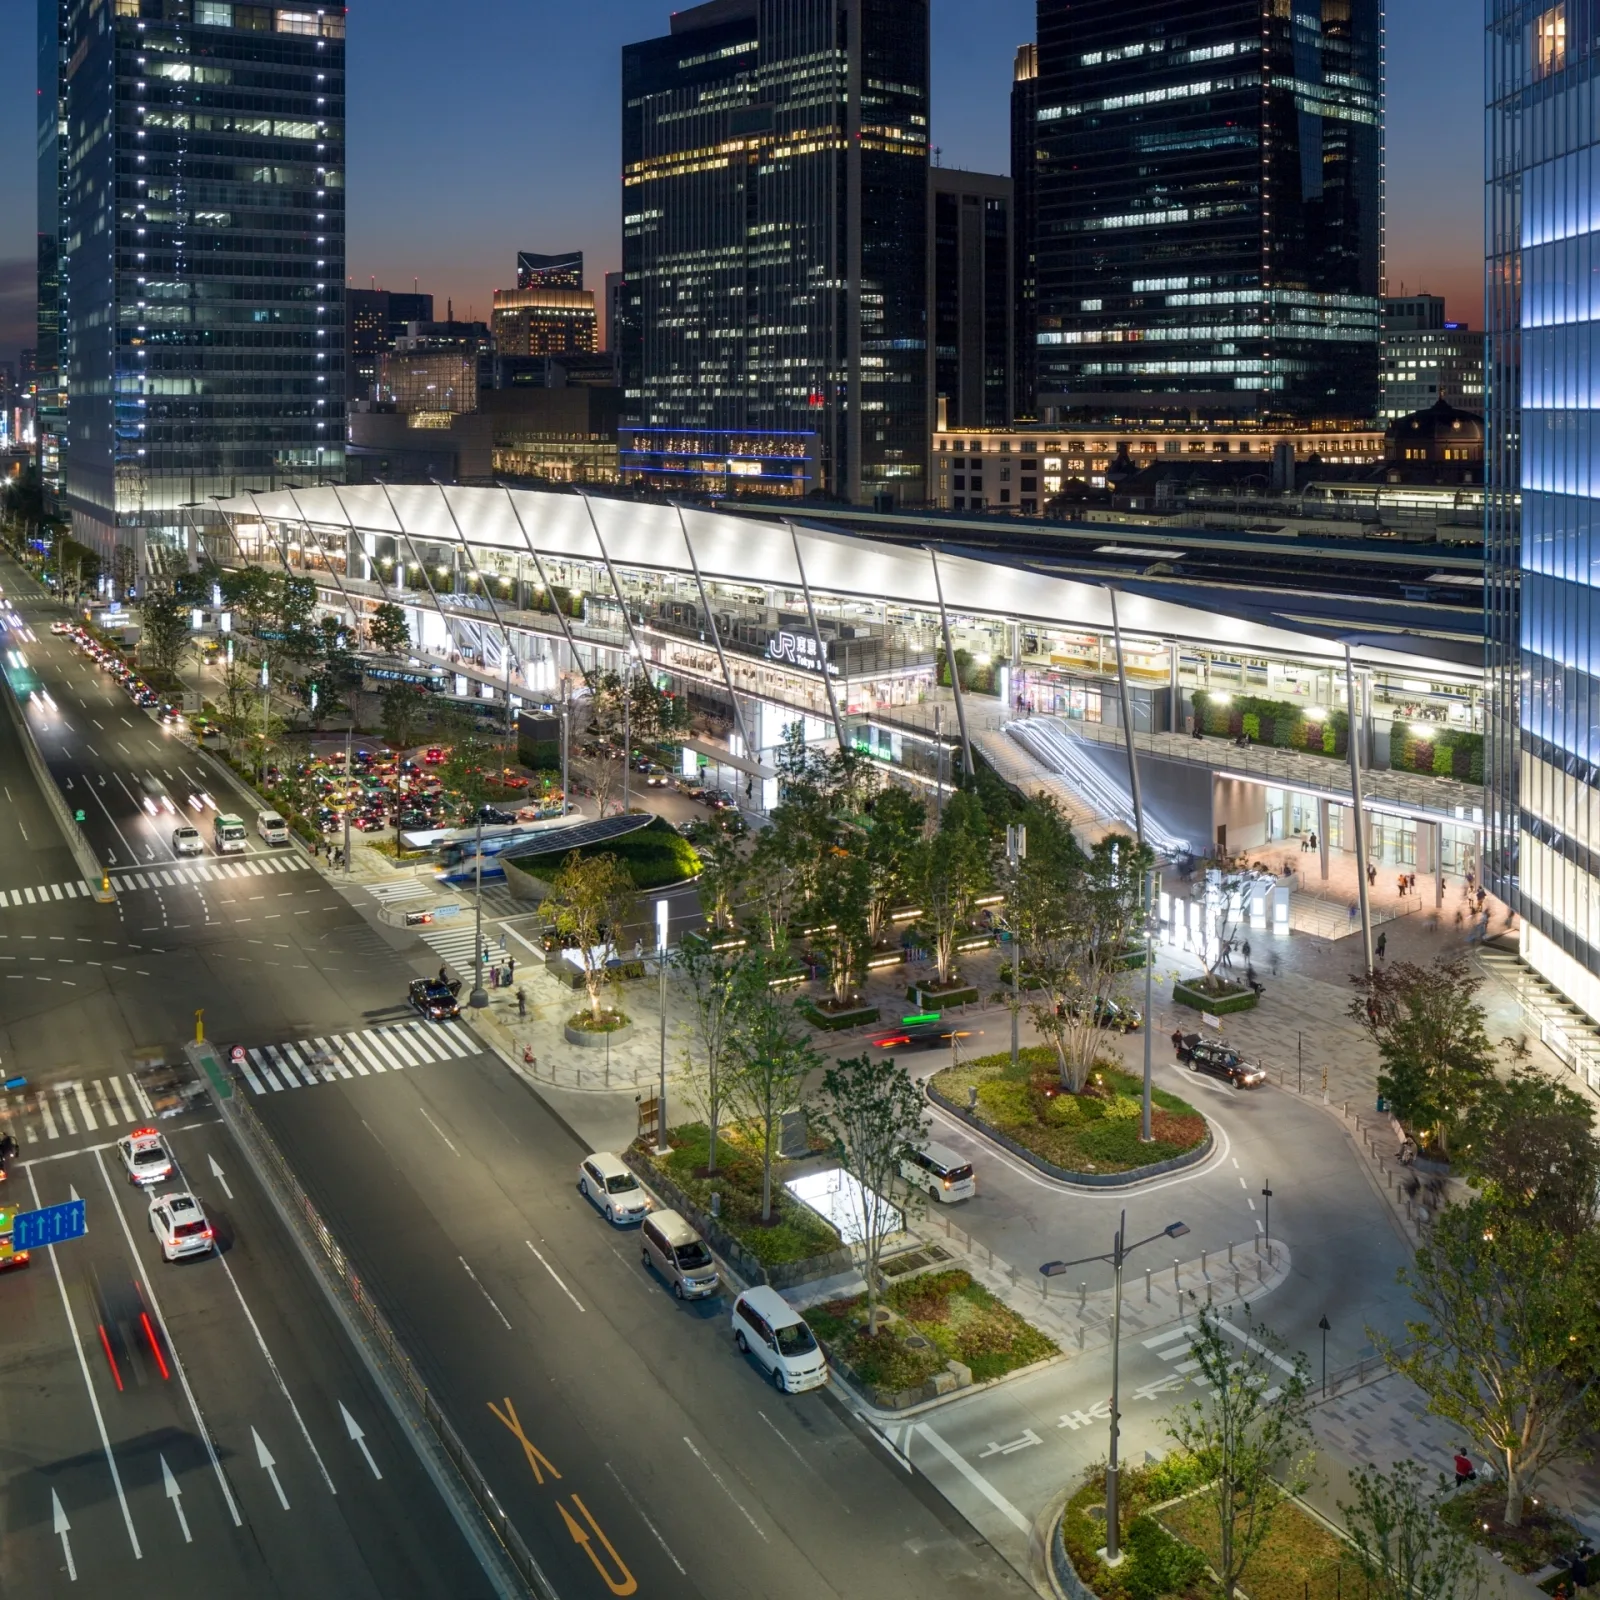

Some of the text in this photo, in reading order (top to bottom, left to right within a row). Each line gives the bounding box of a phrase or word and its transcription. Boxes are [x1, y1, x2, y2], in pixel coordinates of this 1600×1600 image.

[770, 631, 796, 662] JR
[797, 655, 839, 674] Tokyo Stion
[149, 1140, 158, 1149] 2
[979, 1373, 1186, 1458] 止まれ
